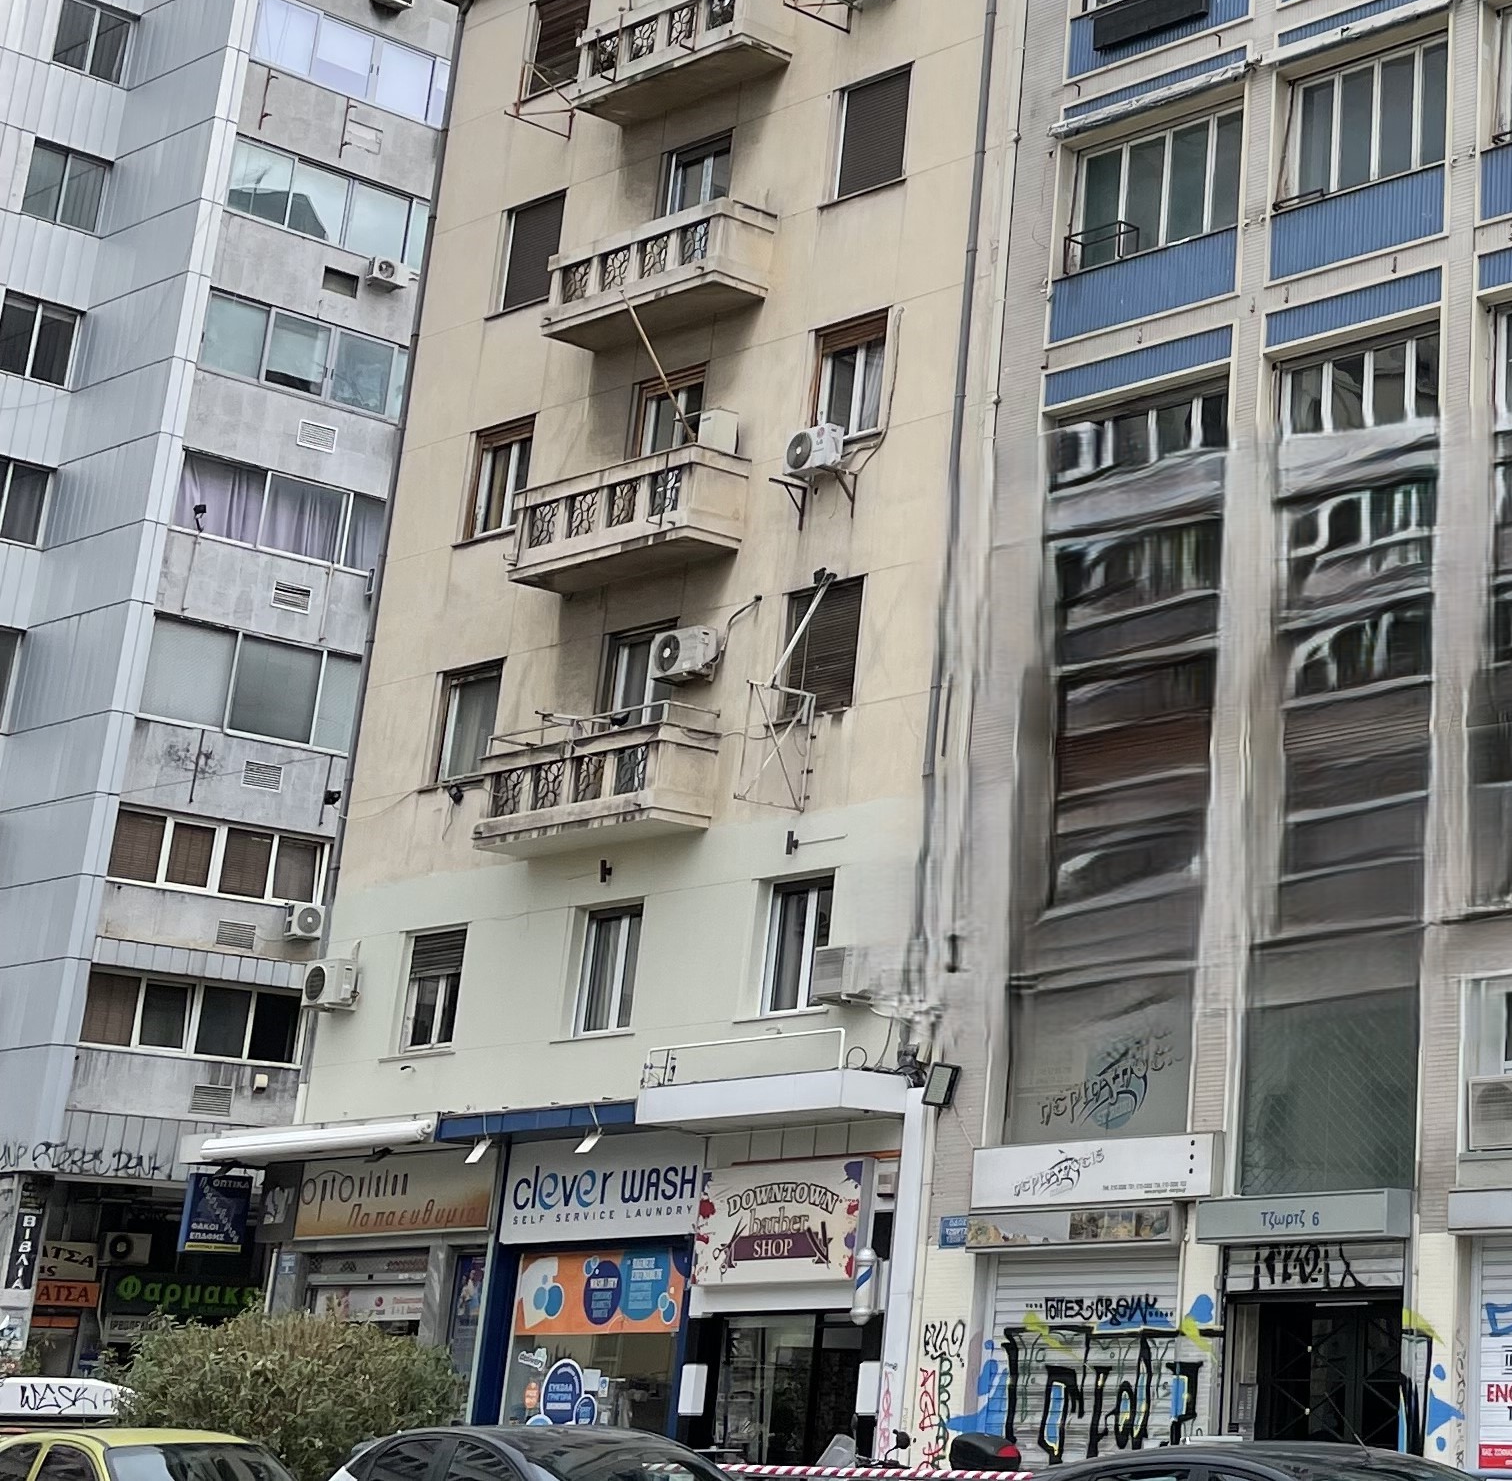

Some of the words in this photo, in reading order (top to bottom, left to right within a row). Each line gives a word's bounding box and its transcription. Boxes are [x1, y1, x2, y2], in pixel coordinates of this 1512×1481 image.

[213, 1179, 249, 1188] ΟΠΤΙΚΑ
[513, 1165, 614, 1210] clever
[621, 1164, 698, 1203] WASH
[728, 1182, 839, 1217] DOWNTOWN
[513, 1214, 545, 1225] SELF
[556, 1210, 615, 1223] SERVICE
[626, 1205, 693, 1218] LAUNDRY
[749, 1206, 809, 1235] barber
[1261, 1209, 1306, 1230] Τζωρτζ
[1312, 1211, 1320, 1226] 6
[753, 1239, 793, 1258] SHOP
